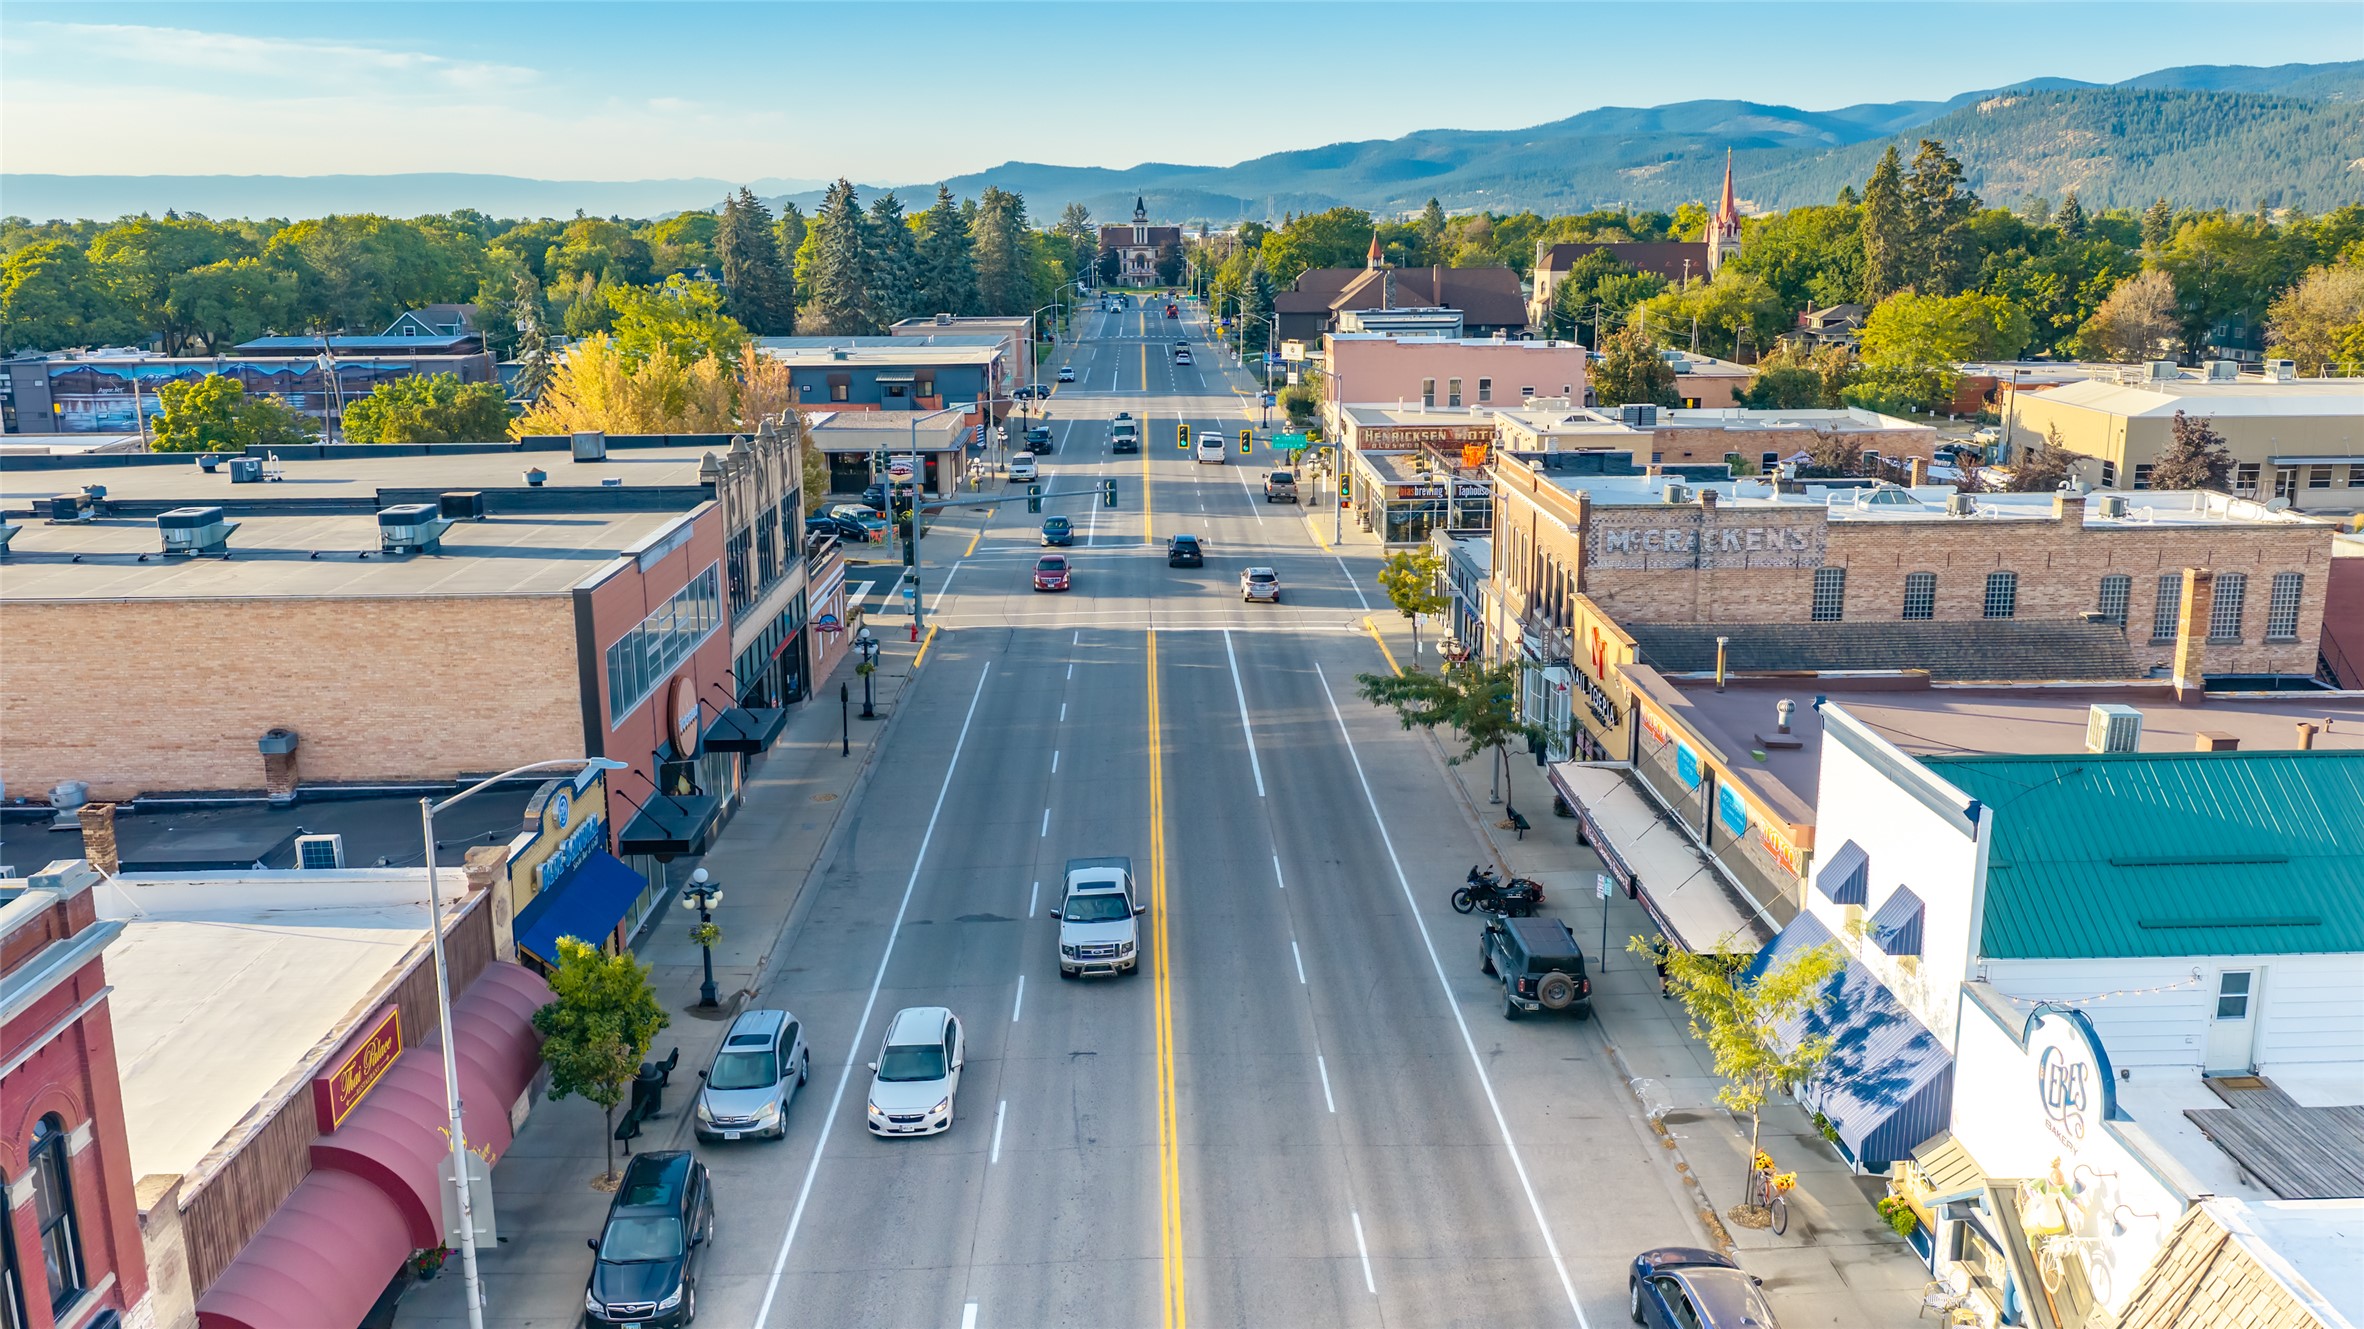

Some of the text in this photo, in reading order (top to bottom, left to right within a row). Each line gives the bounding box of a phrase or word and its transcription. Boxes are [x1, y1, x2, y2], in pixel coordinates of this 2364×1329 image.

[1365, 429, 1447, 442] HENRICKSEN
[1458, 485, 1490, 498] Taphouse
[1570, 664, 1589, 695] NAIL
[541, 850, 565, 892] BLUE
[339, 1036, 393, 1102] Thai Palace
[355, 1064, 381, 1096] RESTAURANT
[2038, 1045, 2088, 1140] CERES
[2044, 1119, 2079, 1156] BAKERY
